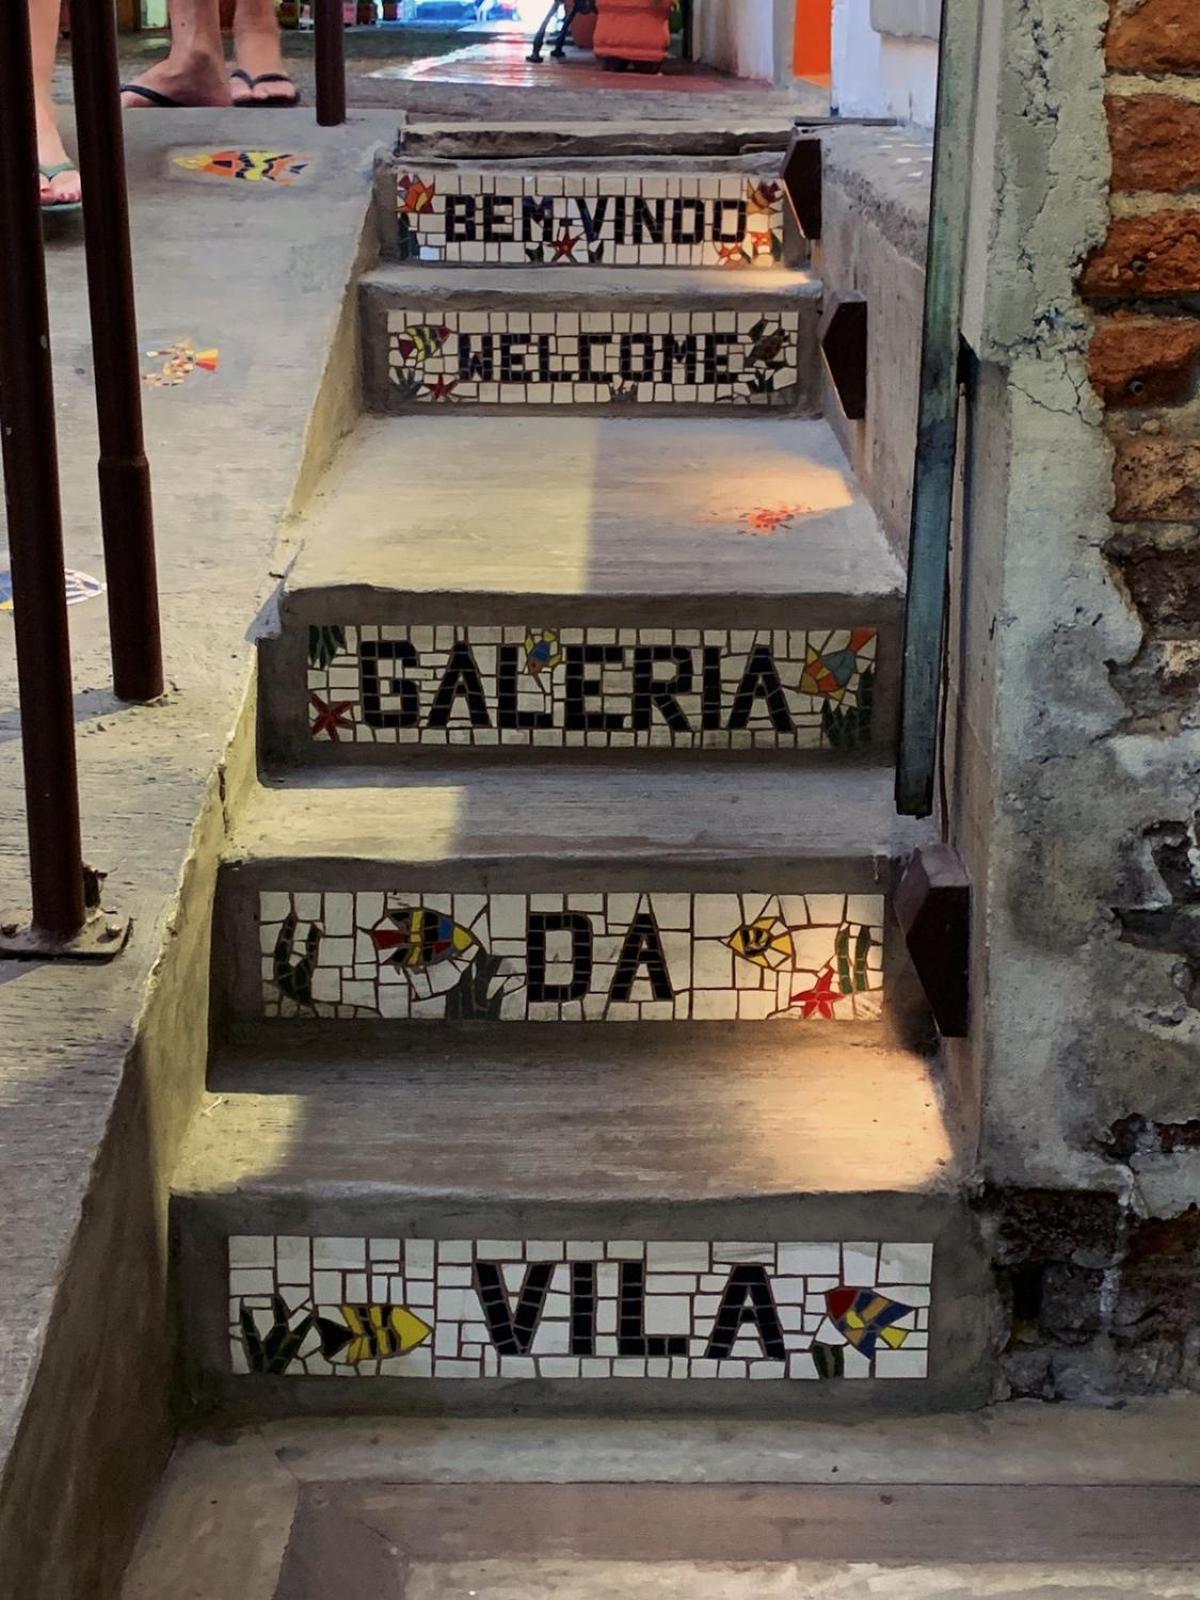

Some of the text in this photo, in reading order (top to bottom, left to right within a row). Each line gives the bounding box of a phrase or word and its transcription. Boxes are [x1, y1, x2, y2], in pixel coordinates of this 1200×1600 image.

[458, 333, 738, 384] WELCOME
[361, 640, 795, 731] GALERIA
[527, 914, 673, 1003] DA
[475, 1262, 787, 1360] VILA
